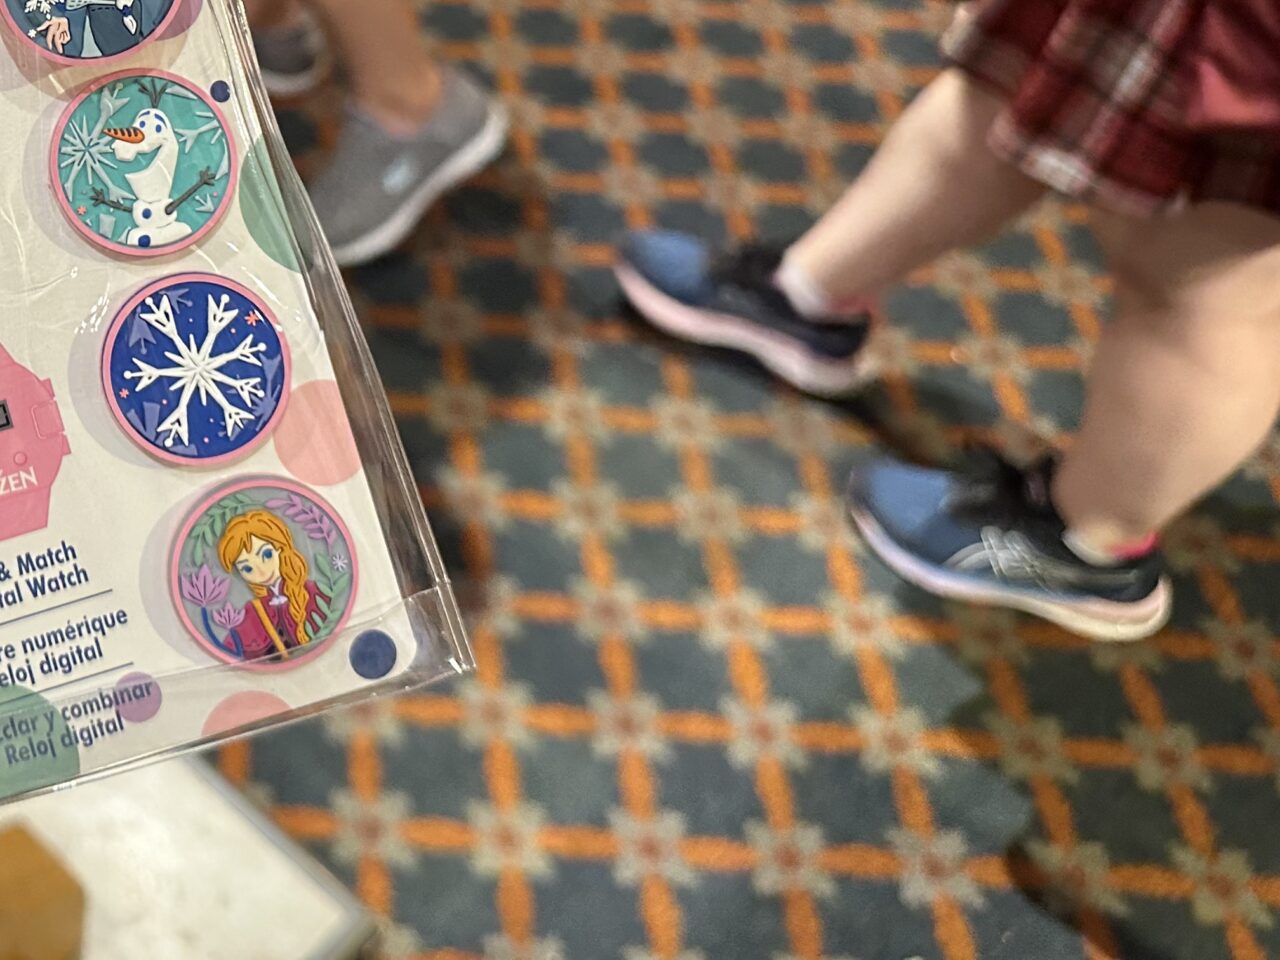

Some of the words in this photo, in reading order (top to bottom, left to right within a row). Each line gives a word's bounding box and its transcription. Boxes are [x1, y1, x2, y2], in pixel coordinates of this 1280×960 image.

[17, 540, 77, 576] Match
[26, 563, 89, 599] Watch
[21, 608, 128, 655] numérique
[39, 637, 103, 674] digital
[43, 711, 55, 732] y
[61, 679, 153, 722] combinar
[5, 734, 57, 767] Reloj
[61, 710, 124, 748] digital
